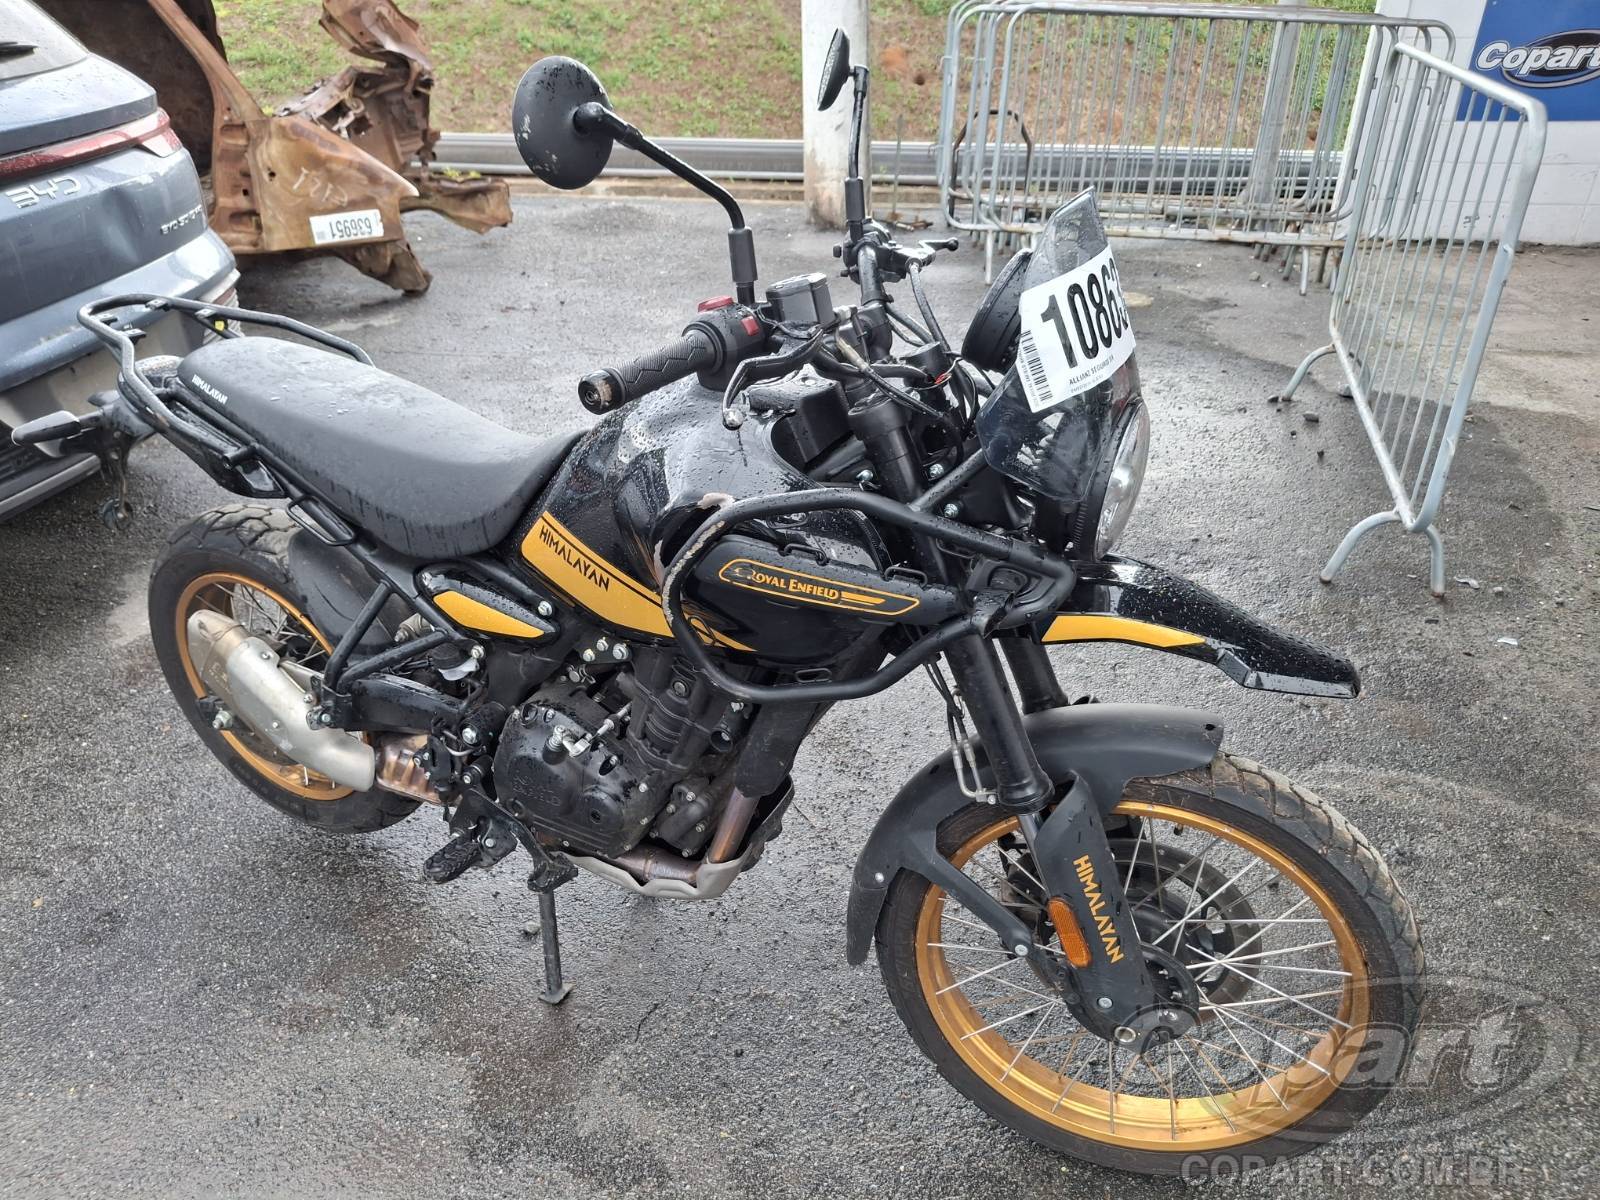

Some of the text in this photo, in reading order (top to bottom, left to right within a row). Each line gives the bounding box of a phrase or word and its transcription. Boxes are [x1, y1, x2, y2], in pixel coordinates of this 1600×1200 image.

[6, 175, 81, 209] BYD
[329, 217, 372, 240] 636951
[191, 374, 228, 405] HIMALAYAN
[539, 525, 609, 592] HIMALAYAN
[788, 578, 840, 600] ENFIELD
[1073, 854, 1125, 964] HIMALAYAN
